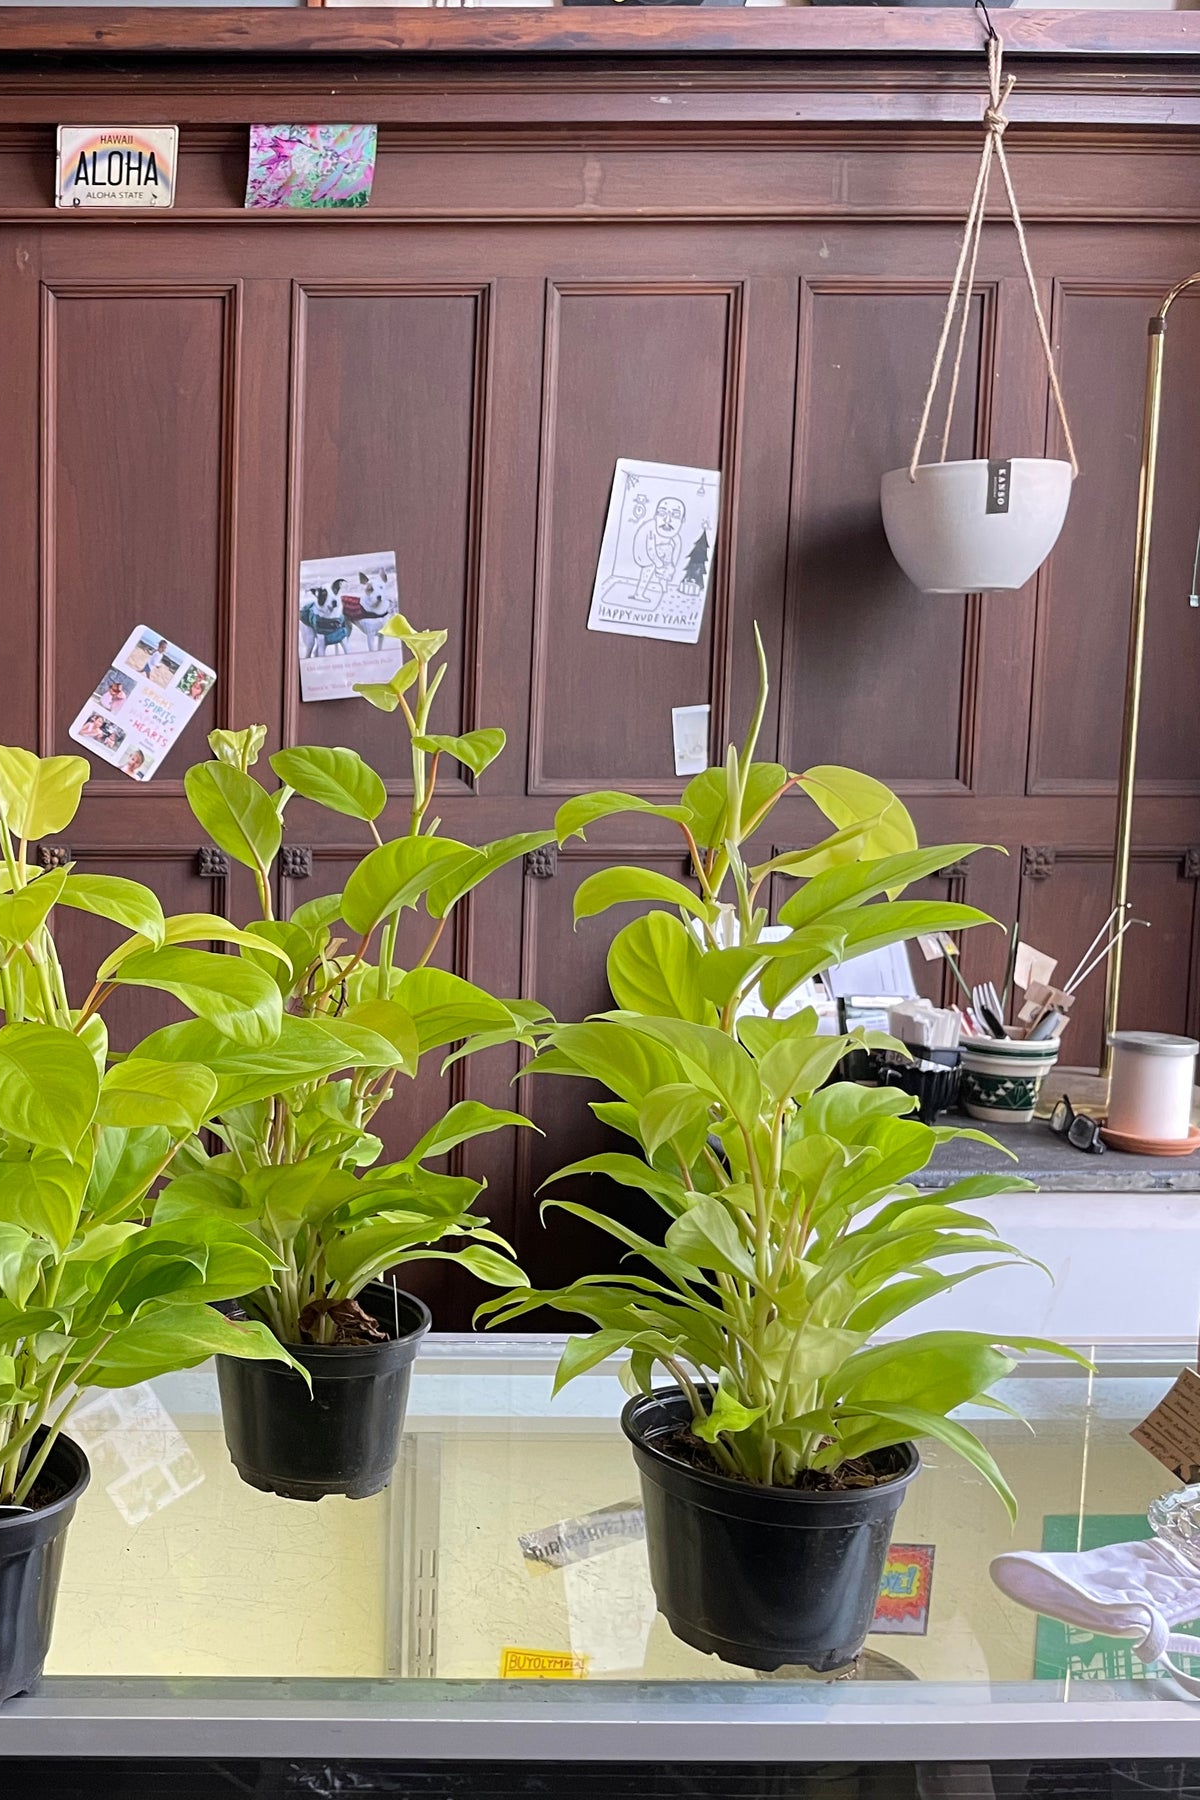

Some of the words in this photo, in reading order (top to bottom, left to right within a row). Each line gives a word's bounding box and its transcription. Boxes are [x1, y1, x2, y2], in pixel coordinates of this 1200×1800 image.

[100, 135, 133, 144] HAWAII
[74, 151, 158, 186] ALOHA
[117, 191, 143, 199] STATE
[997, 469, 1006, 505] KANSO
[598, 605, 633, 620] HAPPY
[633, 613, 660, 623] NUDE
[143, 698, 176, 724] SPIRITS
[132, 720, 168, 747] HEARTS
